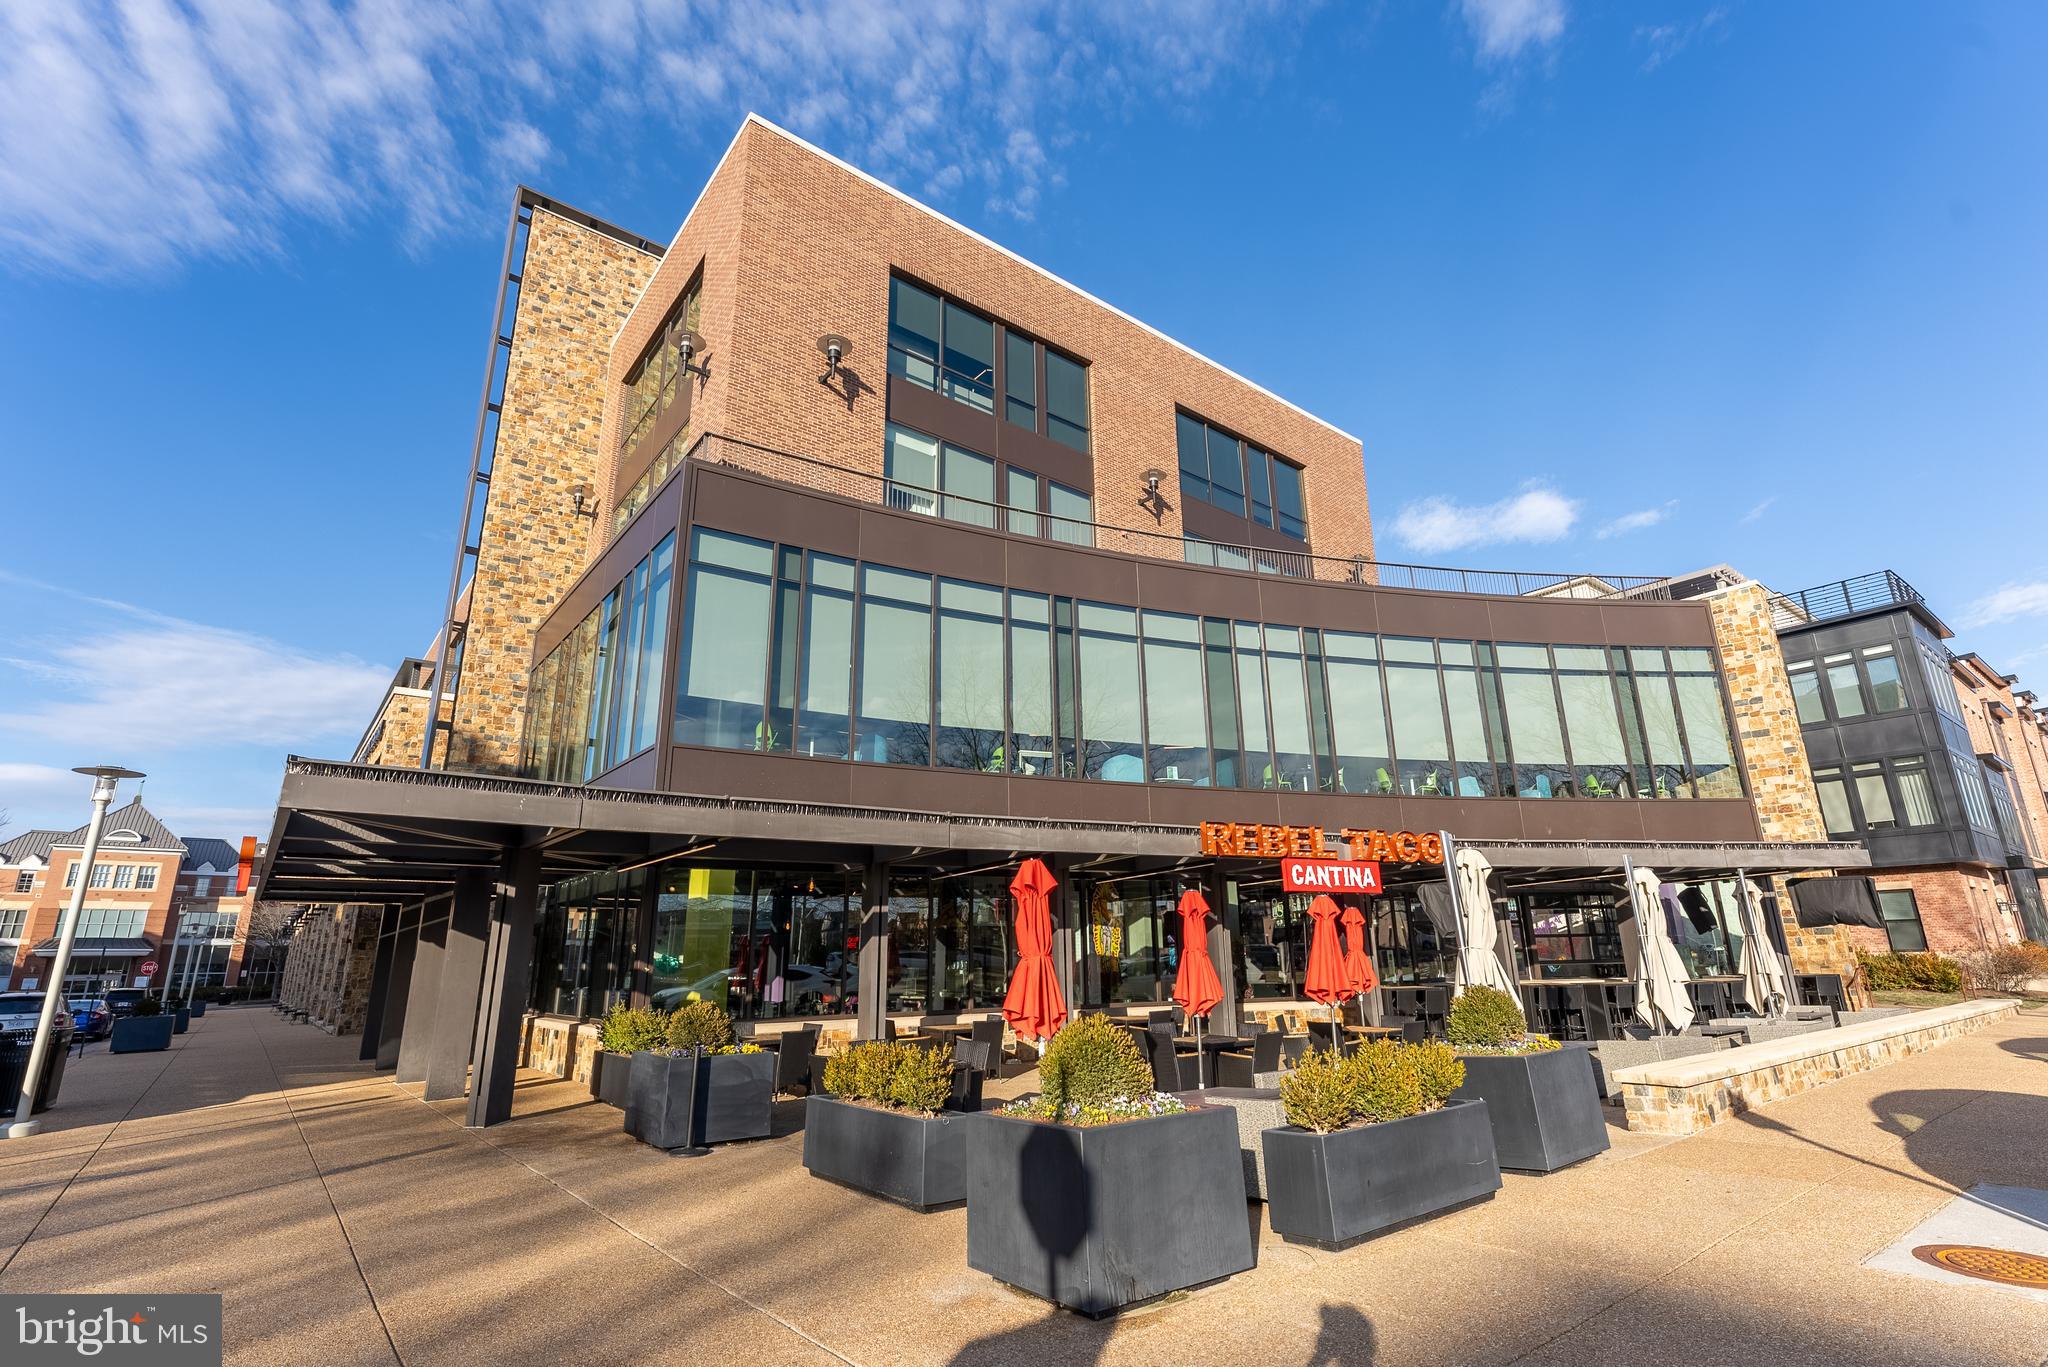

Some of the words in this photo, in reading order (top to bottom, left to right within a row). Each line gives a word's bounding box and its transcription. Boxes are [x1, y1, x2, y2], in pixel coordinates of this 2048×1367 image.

[1200, 821, 1338, 859] REBEL
[1341, 828, 1444, 864] TACO
[1291, 864, 1376, 889] CANTINA
